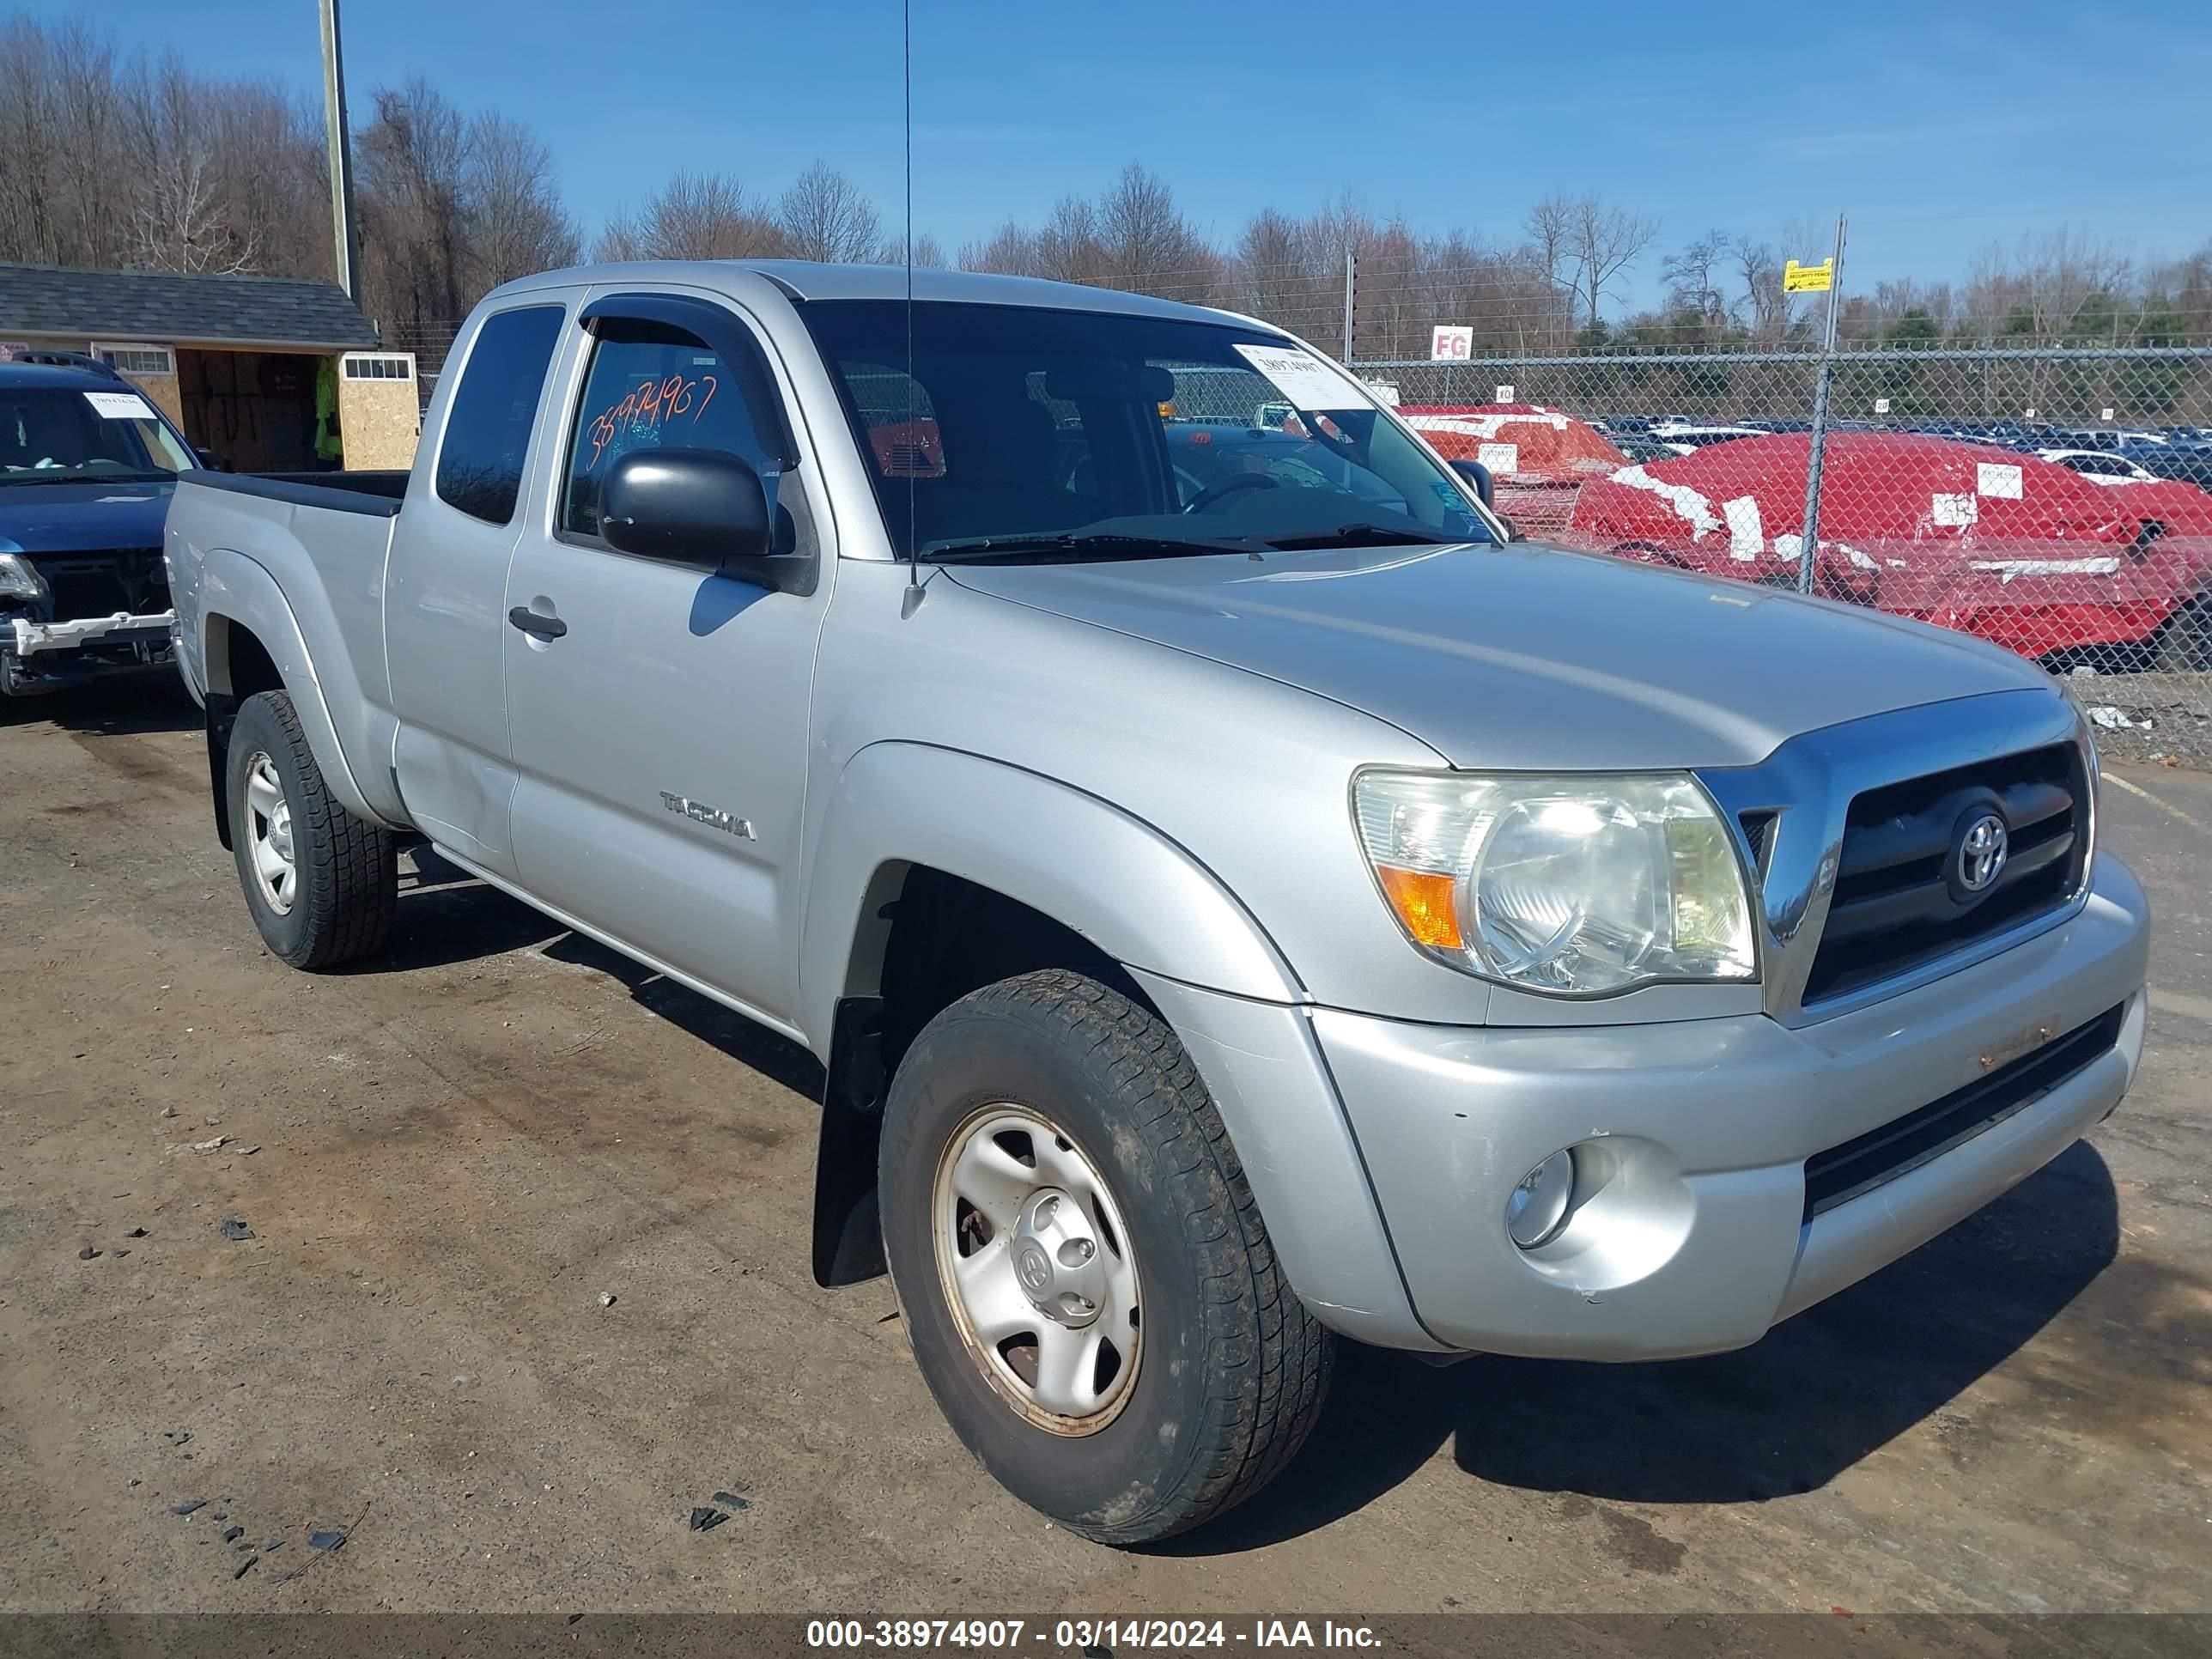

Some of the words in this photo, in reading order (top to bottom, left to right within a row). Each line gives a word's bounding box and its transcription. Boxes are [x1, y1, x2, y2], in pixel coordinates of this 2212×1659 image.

[1437, 335, 1467, 356] FG
[1498, 390, 1511, 399] 10
[659, 790, 757, 842] TACOMA
